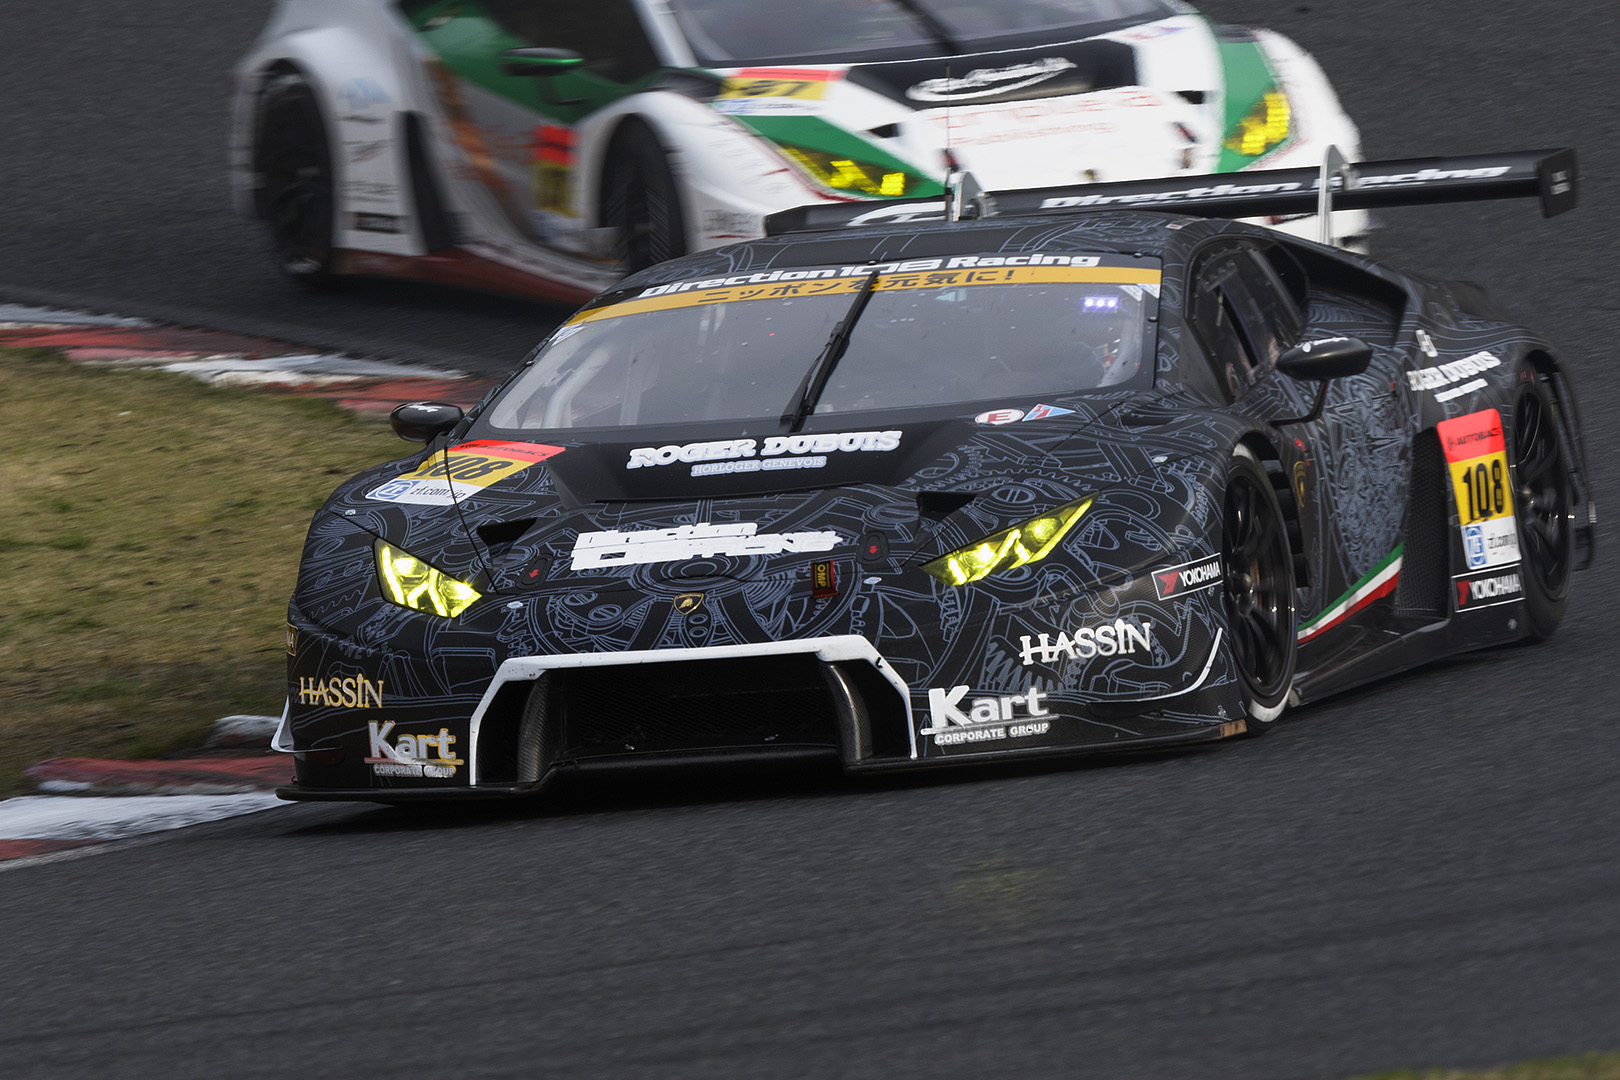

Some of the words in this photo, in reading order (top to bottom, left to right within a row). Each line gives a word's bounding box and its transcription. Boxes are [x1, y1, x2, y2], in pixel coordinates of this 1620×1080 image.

[1039, 181, 1302, 209] Direction
[946, 253, 1101, 269] Racing
[480, 445, 550, 458] AUTOBACS
[627, 439, 757, 469] ROGER
[761, 431, 903, 456] DUBUIS
[415, 455, 514, 481] 108
[692, 458, 759, 476] HORLOGER
[761, 455, 826, 472] GENEVOIS
[1462, 459, 1505, 521] 108
[816, 564, 827, 587] OMP
[1178, 560, 1221, 587] YOKOHAMA
[1469, 573, 1522, 600] YOKOHAMA
[1018, 618, 1151, 666] HASSIN
[299, 673, 385, 709] HASSIN
[928, 685, 1048, 729] Kart
[368, 720, 456, 760] Kart
[935, 728, 1006, 746] CORPORATE
[1009, 722, 1050, 737] GROUP
[374, 764, 423, 777] CORPORATE
